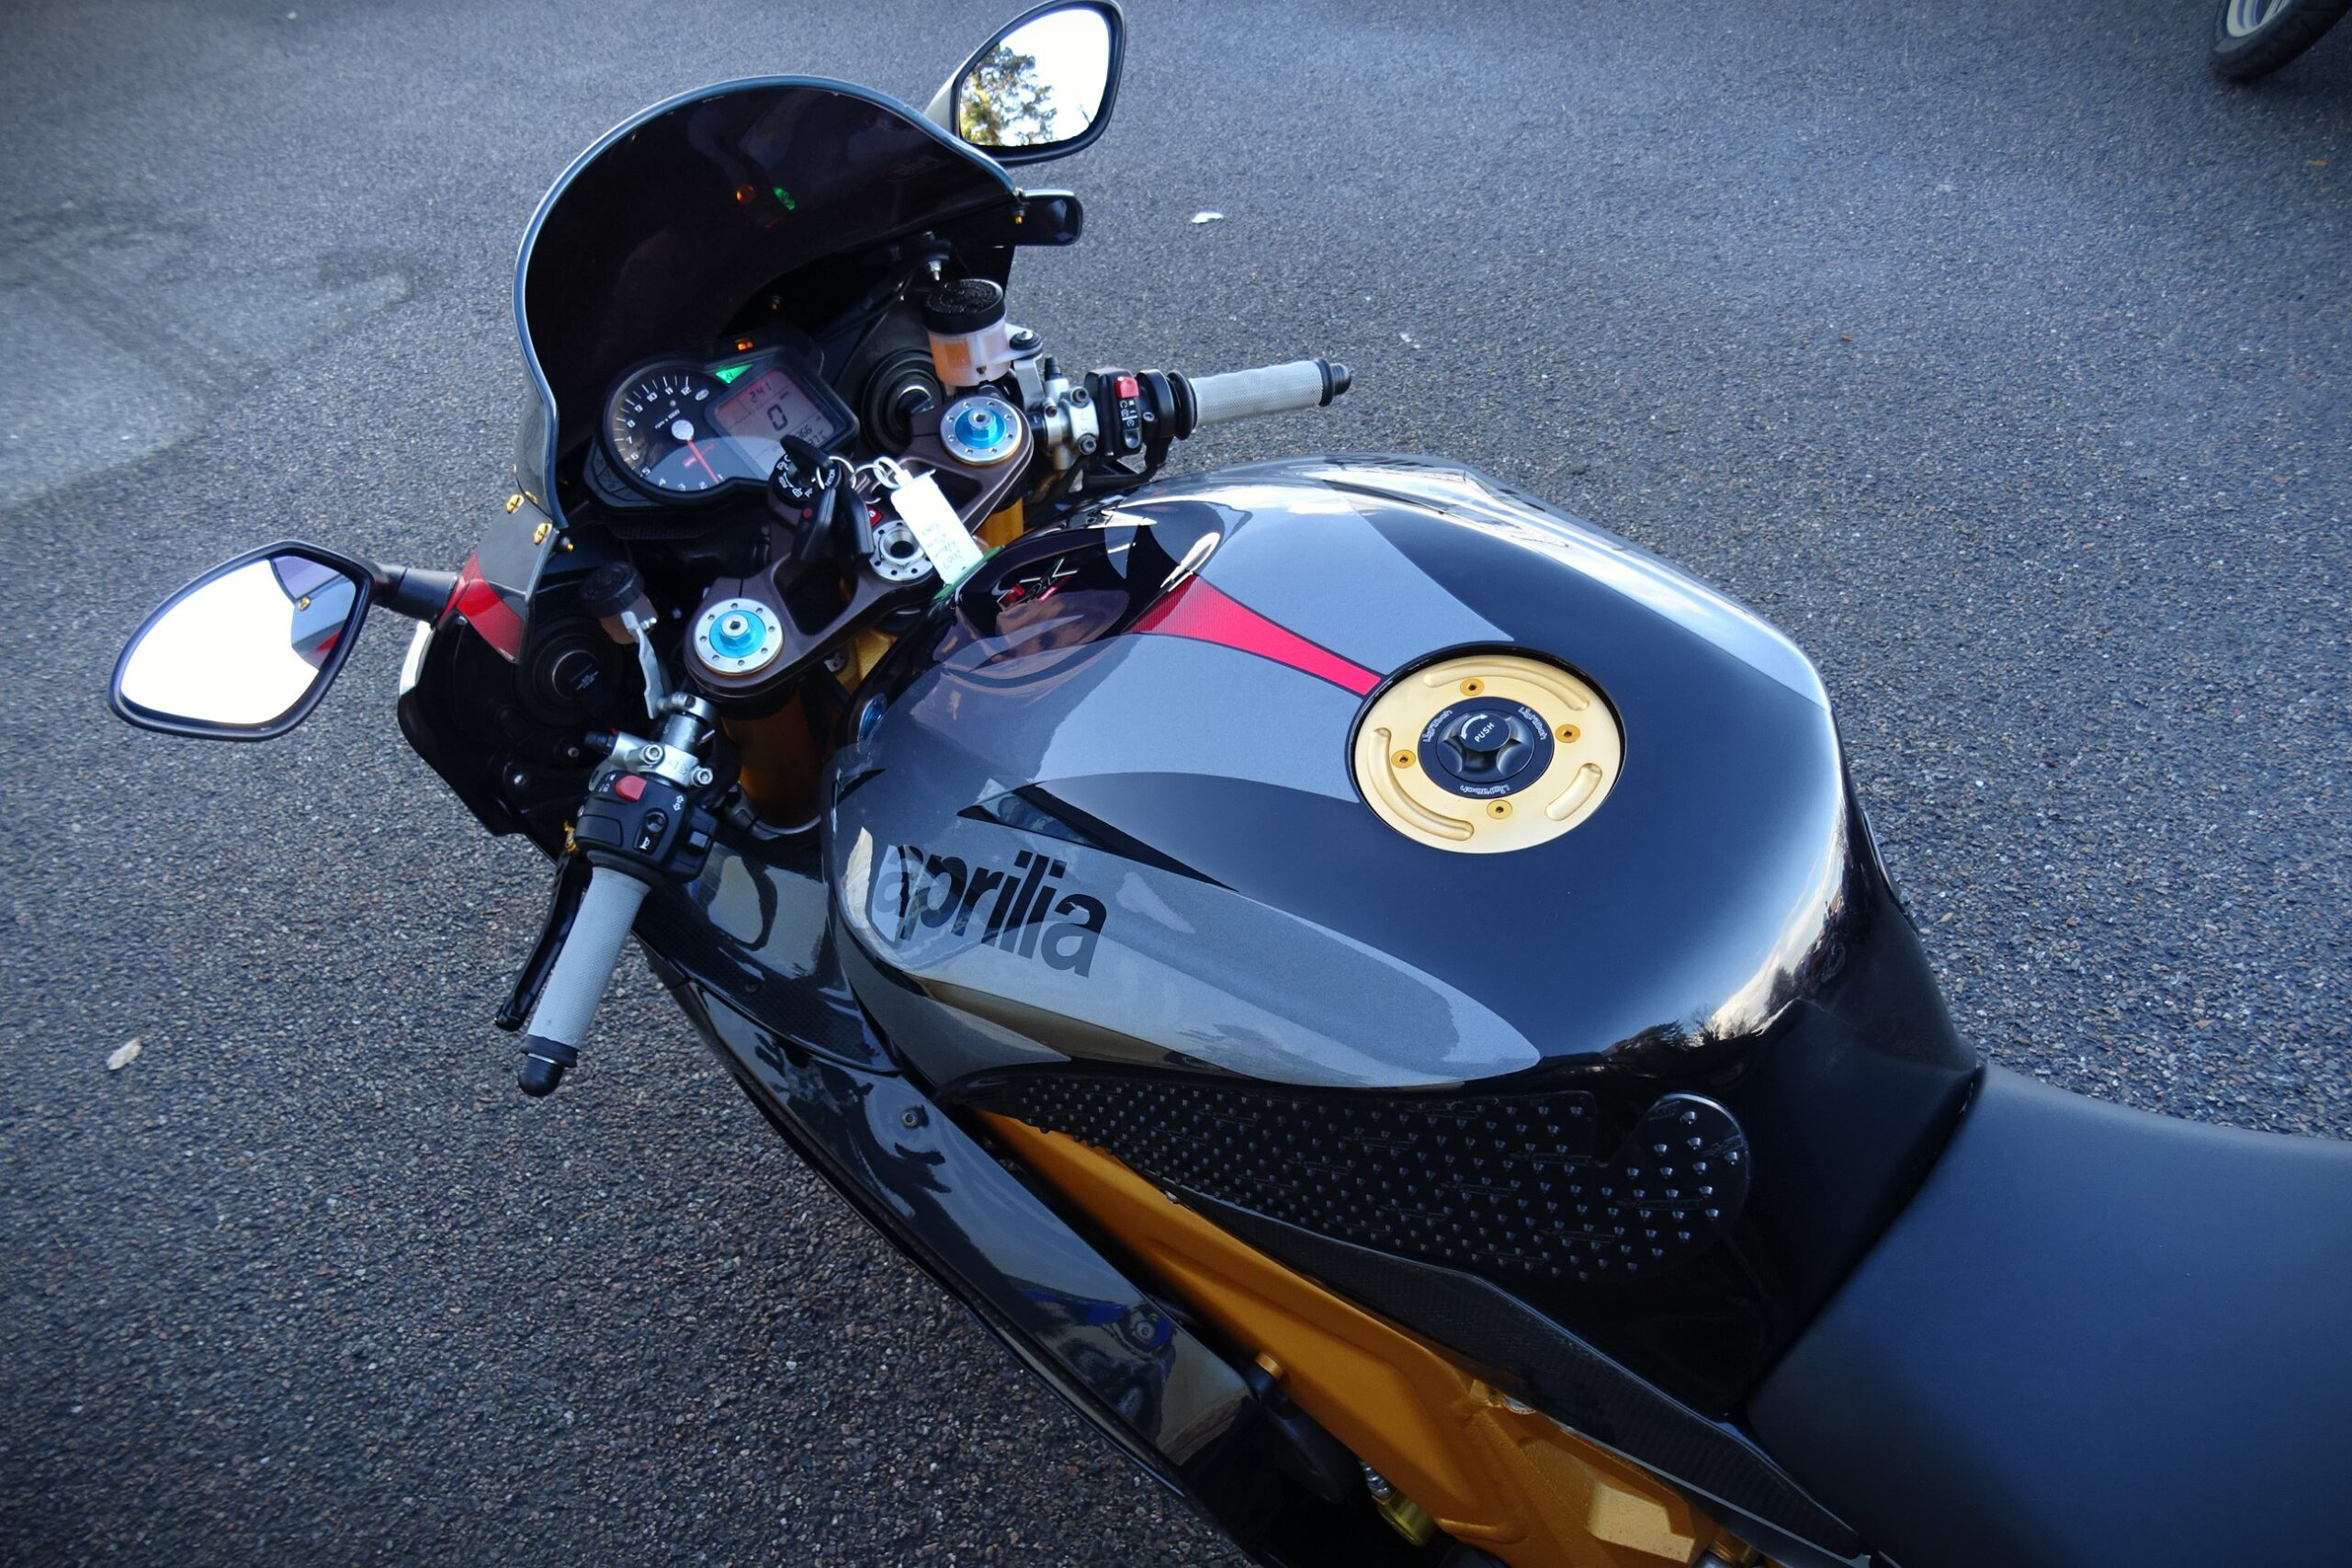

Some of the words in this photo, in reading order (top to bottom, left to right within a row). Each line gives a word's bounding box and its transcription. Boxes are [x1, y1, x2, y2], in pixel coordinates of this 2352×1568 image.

[681, 387, 692, 396] 12
[647, 392, 658, 402] 10
[634, 405, 643, 413] 9
[767, 404, 788, 431] 0
[626, 435, 633, 445] 7
[630, 452, 639, 460] 6
[1474, 722, 1495, 742] PUSH
[871, 843, 1108, 978] aprilia
